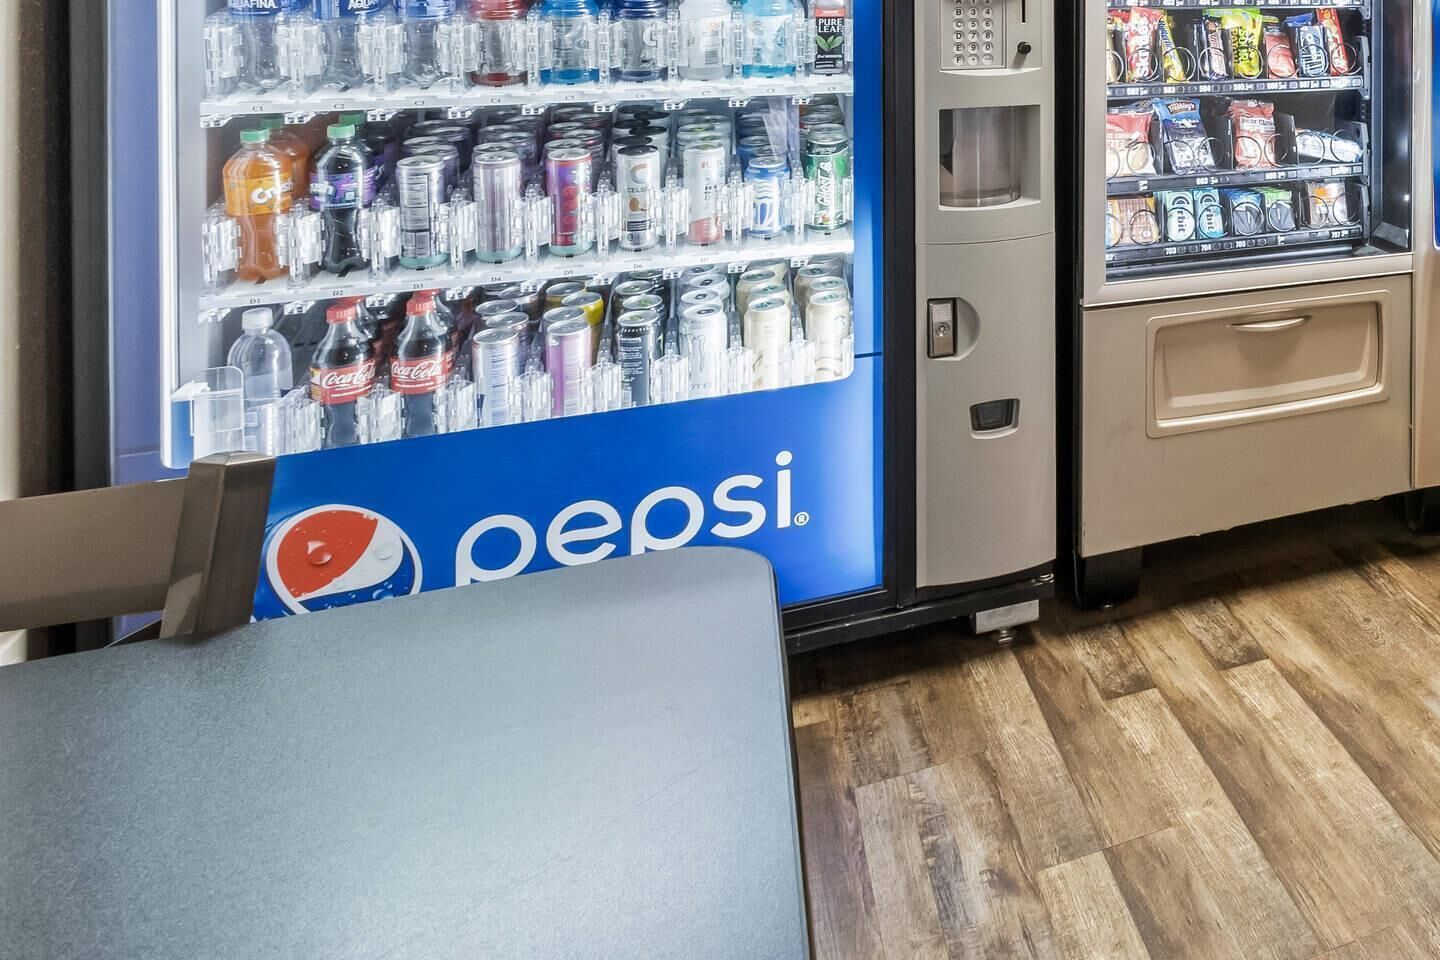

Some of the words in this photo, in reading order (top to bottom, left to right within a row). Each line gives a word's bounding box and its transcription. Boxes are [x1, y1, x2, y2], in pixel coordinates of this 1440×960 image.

[818, 18, 843, 26] PURE
[818, 25, 843, 33] LEAF
[251, 177, 294, 204] Crsh
[391, 358, 443, 380] Coca-Cola
